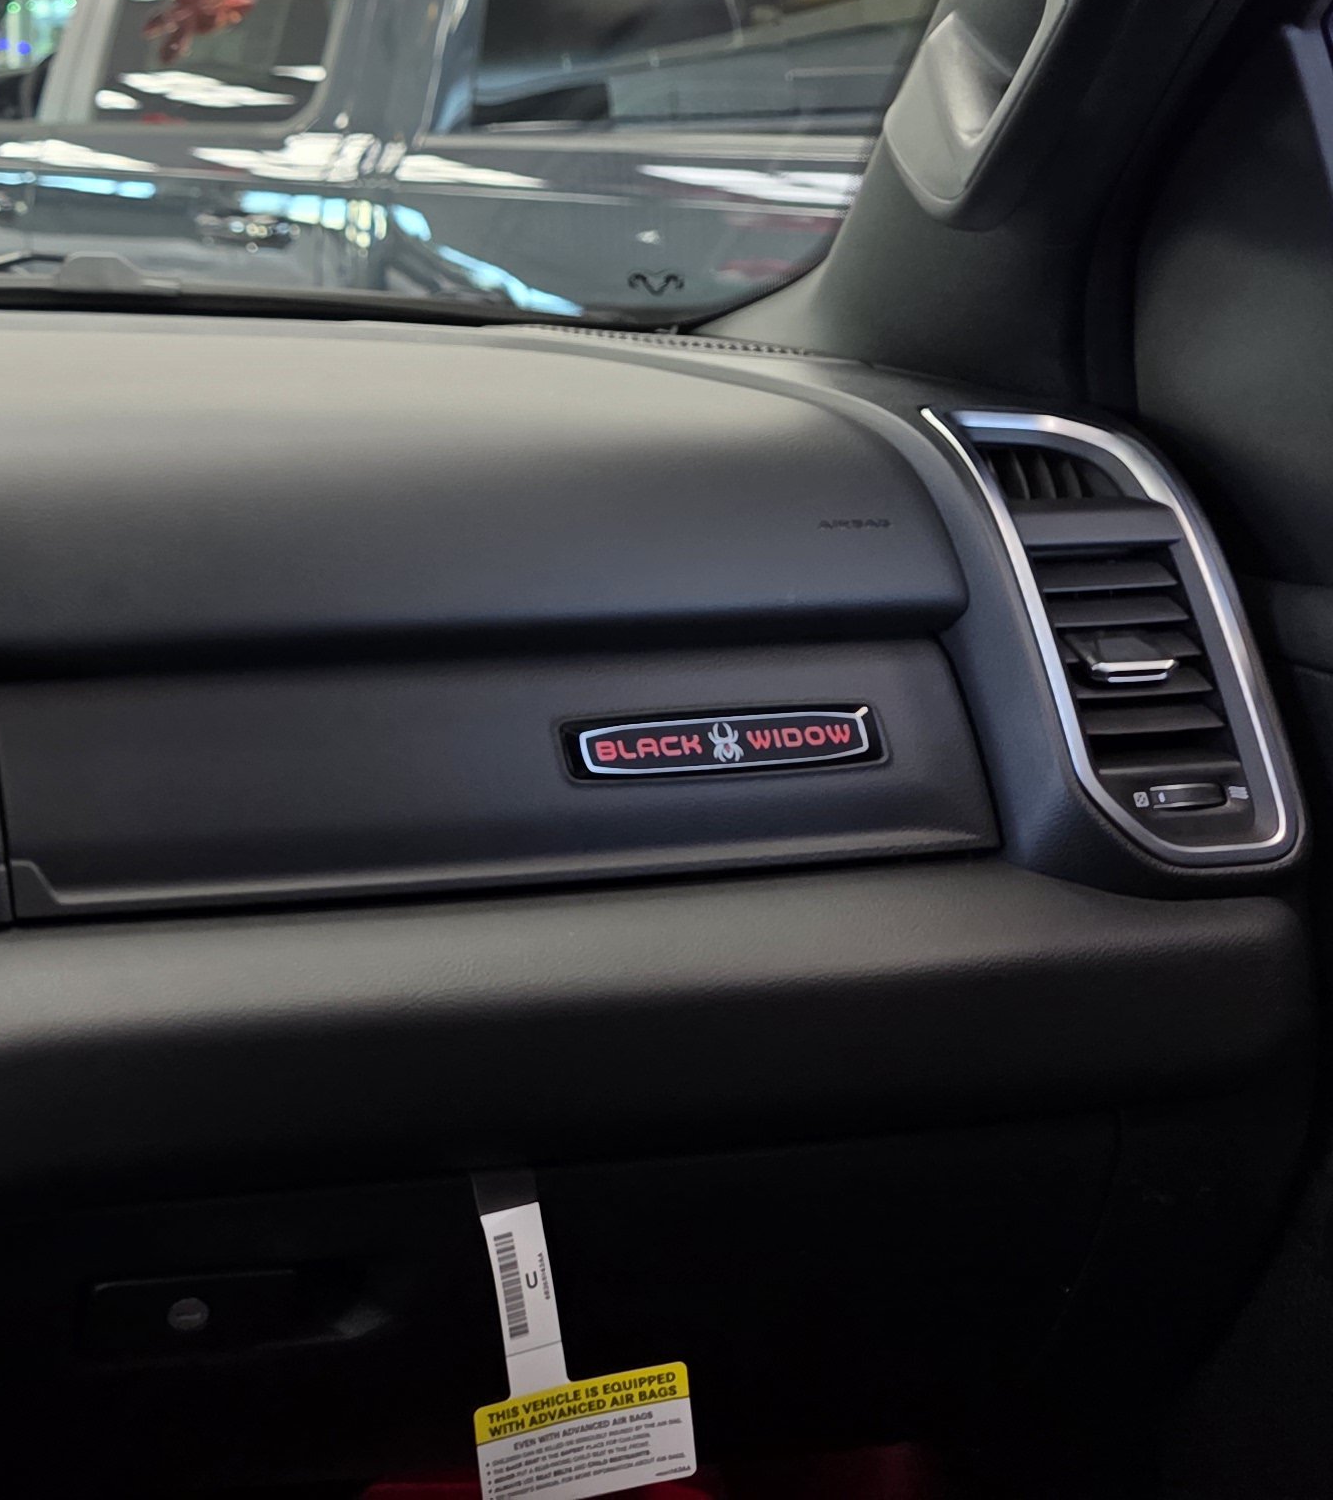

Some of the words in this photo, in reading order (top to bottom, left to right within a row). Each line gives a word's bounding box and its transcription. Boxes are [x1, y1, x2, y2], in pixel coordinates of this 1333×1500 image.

[595, 733, 703, 762] BLACK
[746, 723, 852, 750] WIDOW
[487, 1408, 520, 1424] THIS
[521, 1389, 581, 1415] VEHICLE
[585, 1385, 599, 1398] IS
[602, 1371, 676, 1395] EQUIPPED
[488, 1419, 525, 1438] WITH
[528, 1400, 607, 1426] ADVANCED
[610, 1393, 635, 1408] AIR
[638, 1385, 678, 1401] BAGS
[514, 1438, 537, 1451] EVEN
[538, 1431, 560, 1444] WITH
[561, 1420, 610, 1437] ADVANCED
[612, 1417, 627, 1426] AIR
[629, 1411, 654, 1423] BAGS
